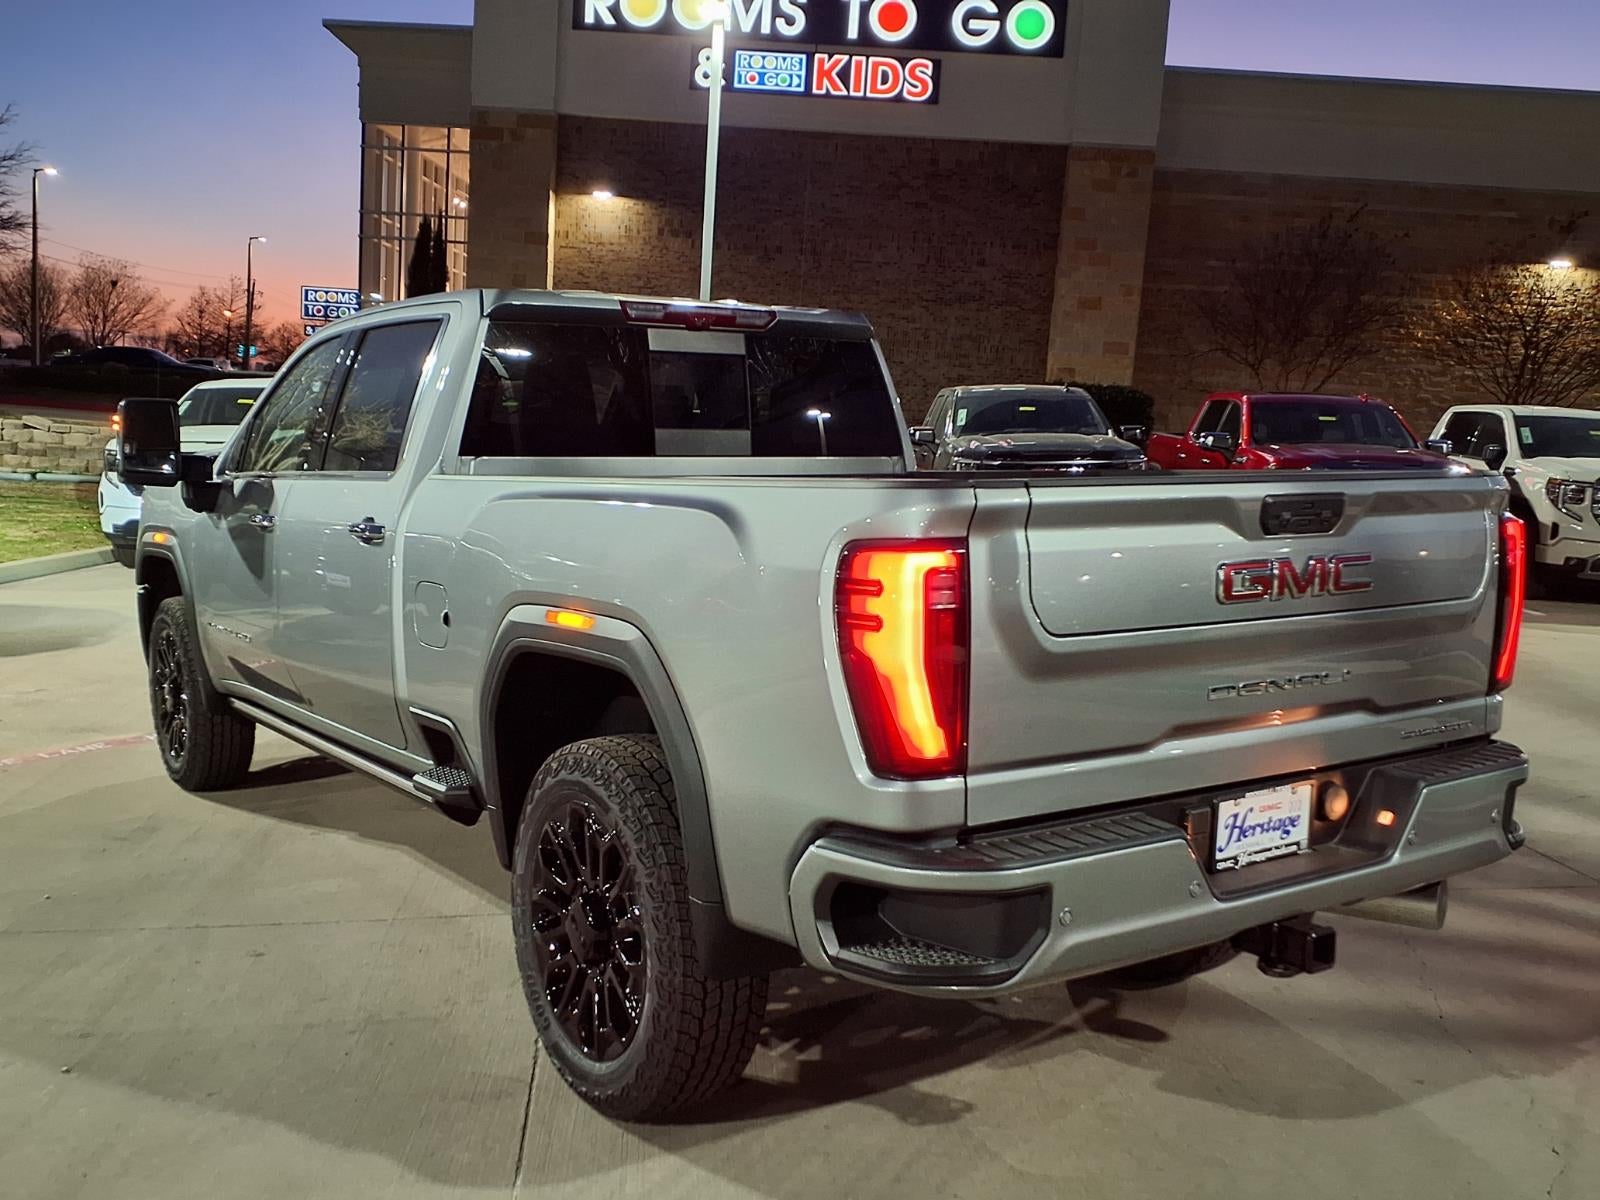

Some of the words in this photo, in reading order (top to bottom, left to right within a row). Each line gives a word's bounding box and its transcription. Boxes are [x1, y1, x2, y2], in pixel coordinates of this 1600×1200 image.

[847, 0, 918, 42] TO
[951, 0, 1056, 49] GO
[694, 47, 725, 88] &
[740, 53, 801, 71] ROOMS
[812, 53, 934, 101] KIDS
[740, 71, 759, 84] TO
[764, 72, 788, 86] GO
[307, 290, 357, 304] ROOMS
[307, 305, 324, 317] TO
[327, 306, 349, 318] GO
[1216, 552, 1375, 605] GMC
[1207, 669, 1350, 701] DENALI
[1258, 801, 1283, 813] GMC
[1217, 806, 1301, 853] Heritage
